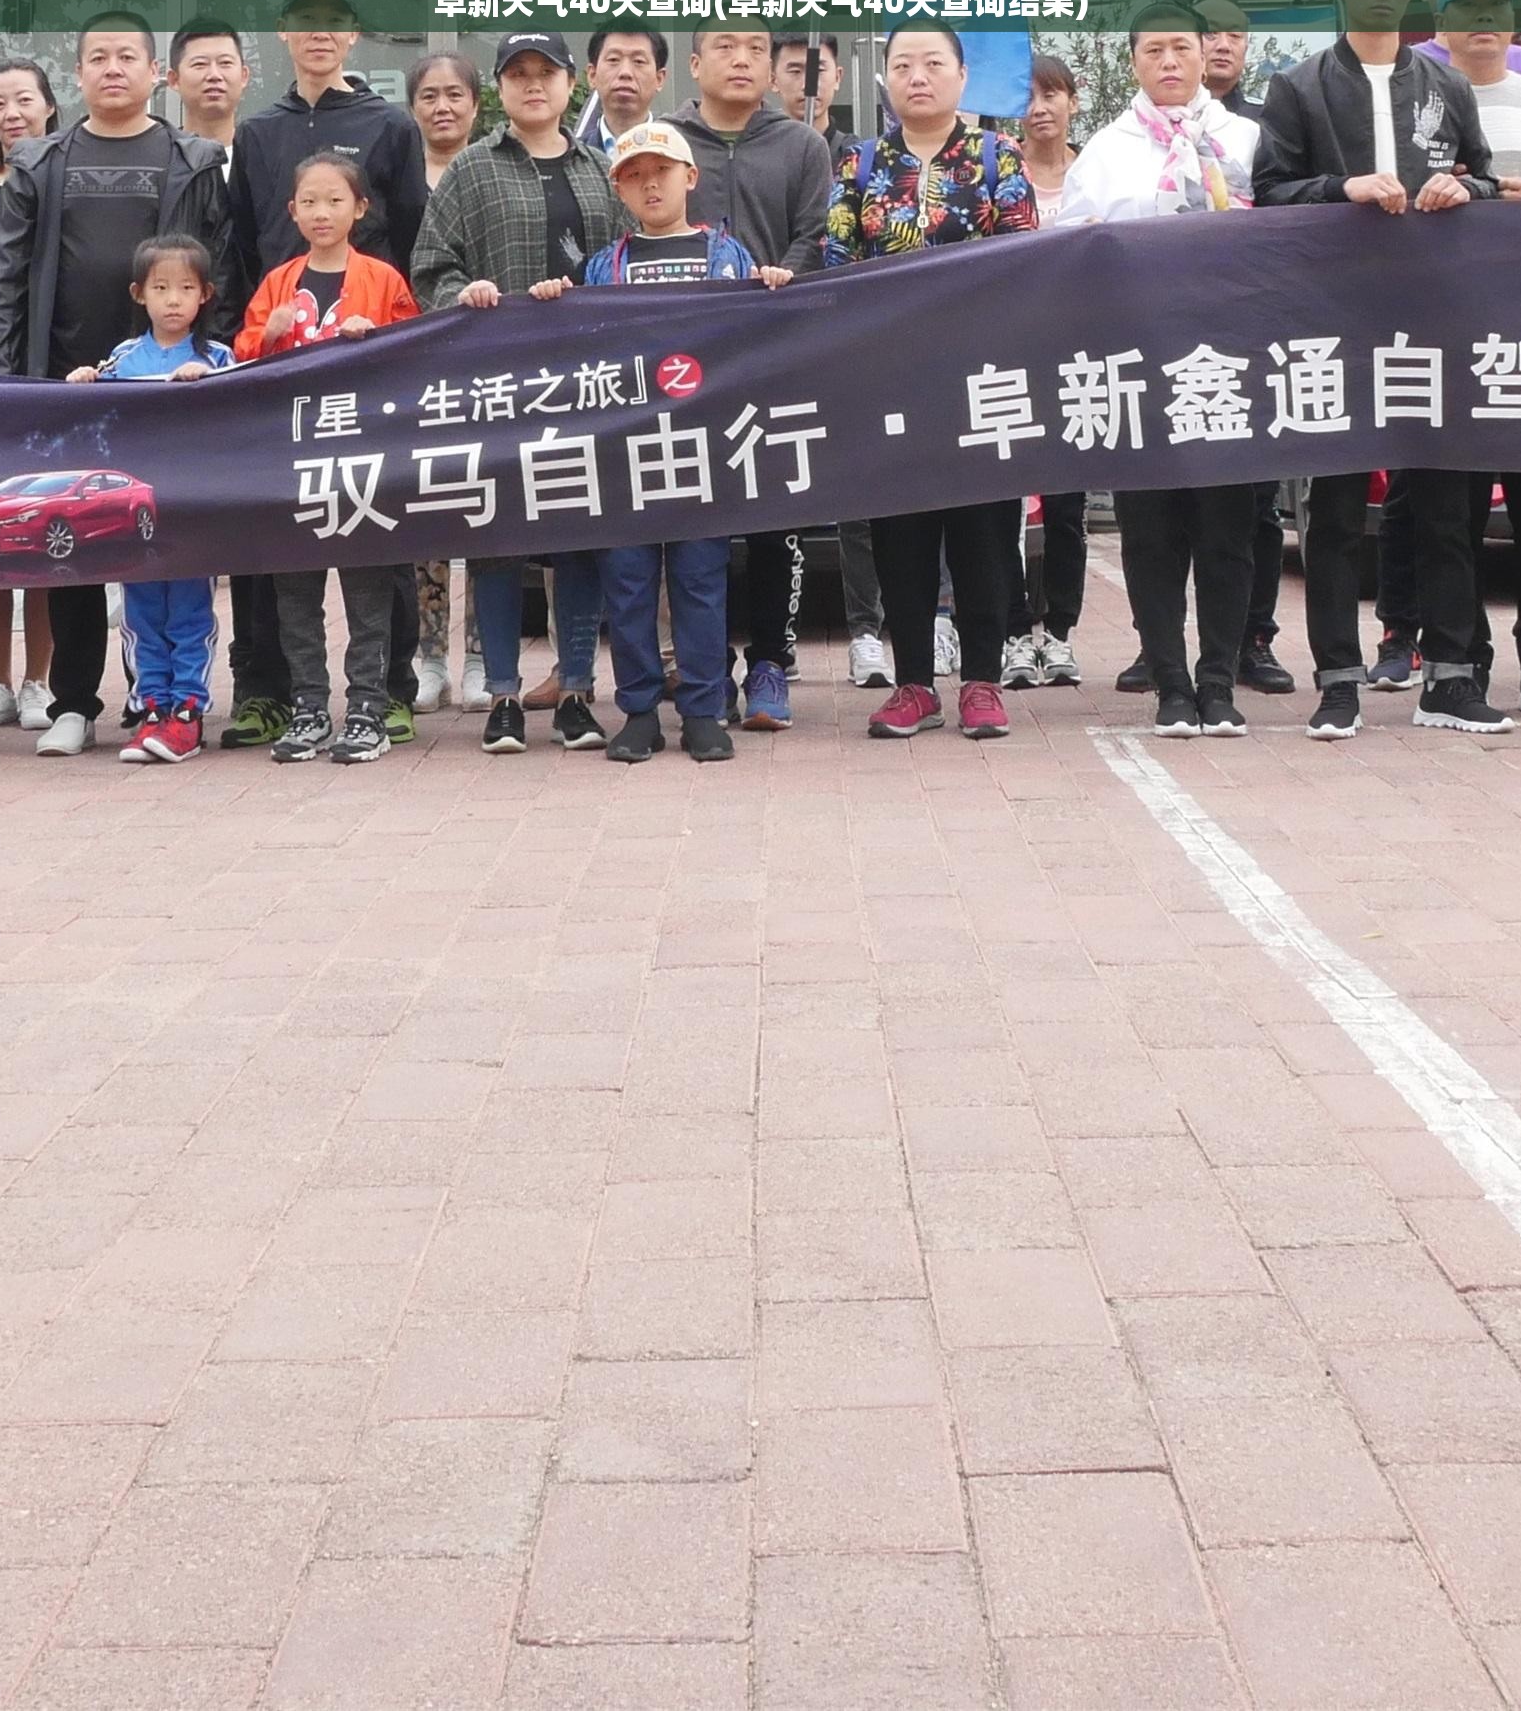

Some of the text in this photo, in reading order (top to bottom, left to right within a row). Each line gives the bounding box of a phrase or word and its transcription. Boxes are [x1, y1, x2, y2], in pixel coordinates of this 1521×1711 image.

[292, 400, 828, 541] 驭马自由行
